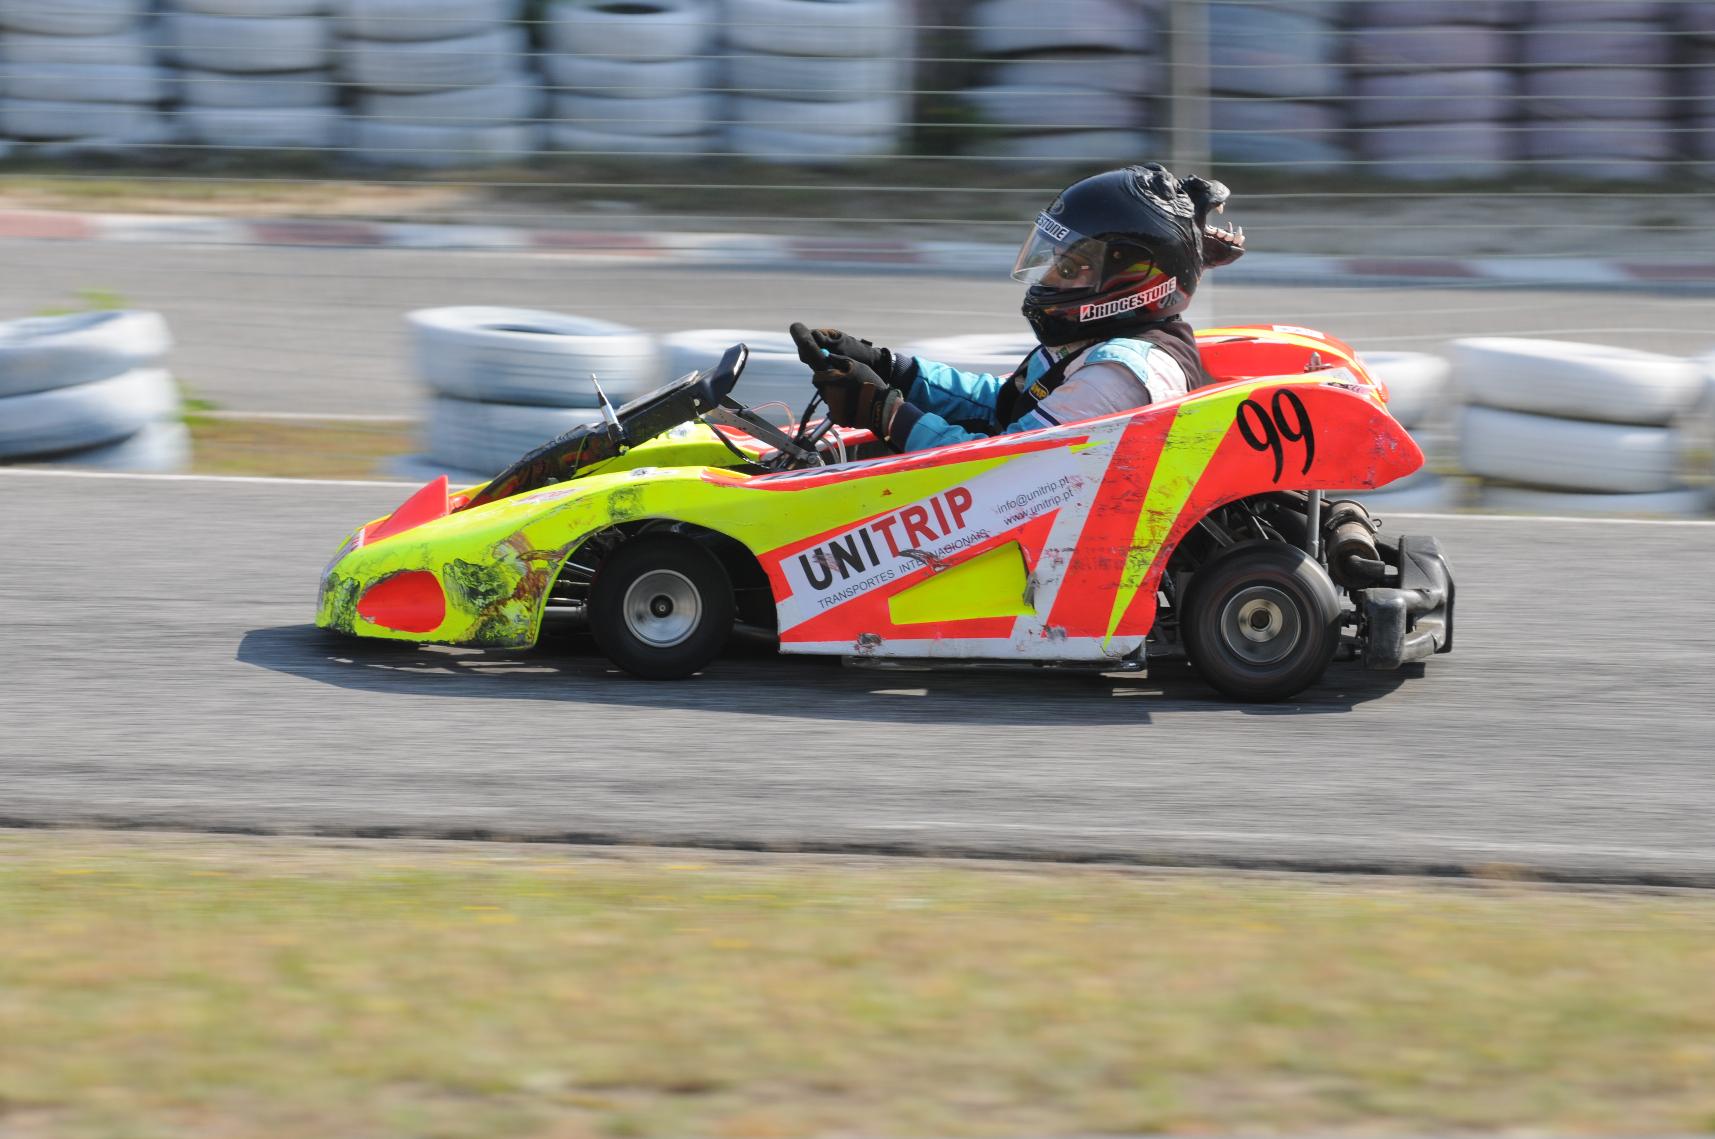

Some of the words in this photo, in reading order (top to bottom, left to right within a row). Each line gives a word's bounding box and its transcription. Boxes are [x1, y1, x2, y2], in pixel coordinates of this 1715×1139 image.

[1082, 280, 1176, 320] BRIDGESTONE
[1236, 389, 1315, 484] 99
[997, 476, 1070, 514] info@unitrip.pt
[1003, 488, 1075, 526] www.unitrip.pt
[798, 486, 973, 591] UNITRIP
[817, 569, 896, 609] TRANSPORTES
[899, 528, 990, 574] INTENACIONAIS
